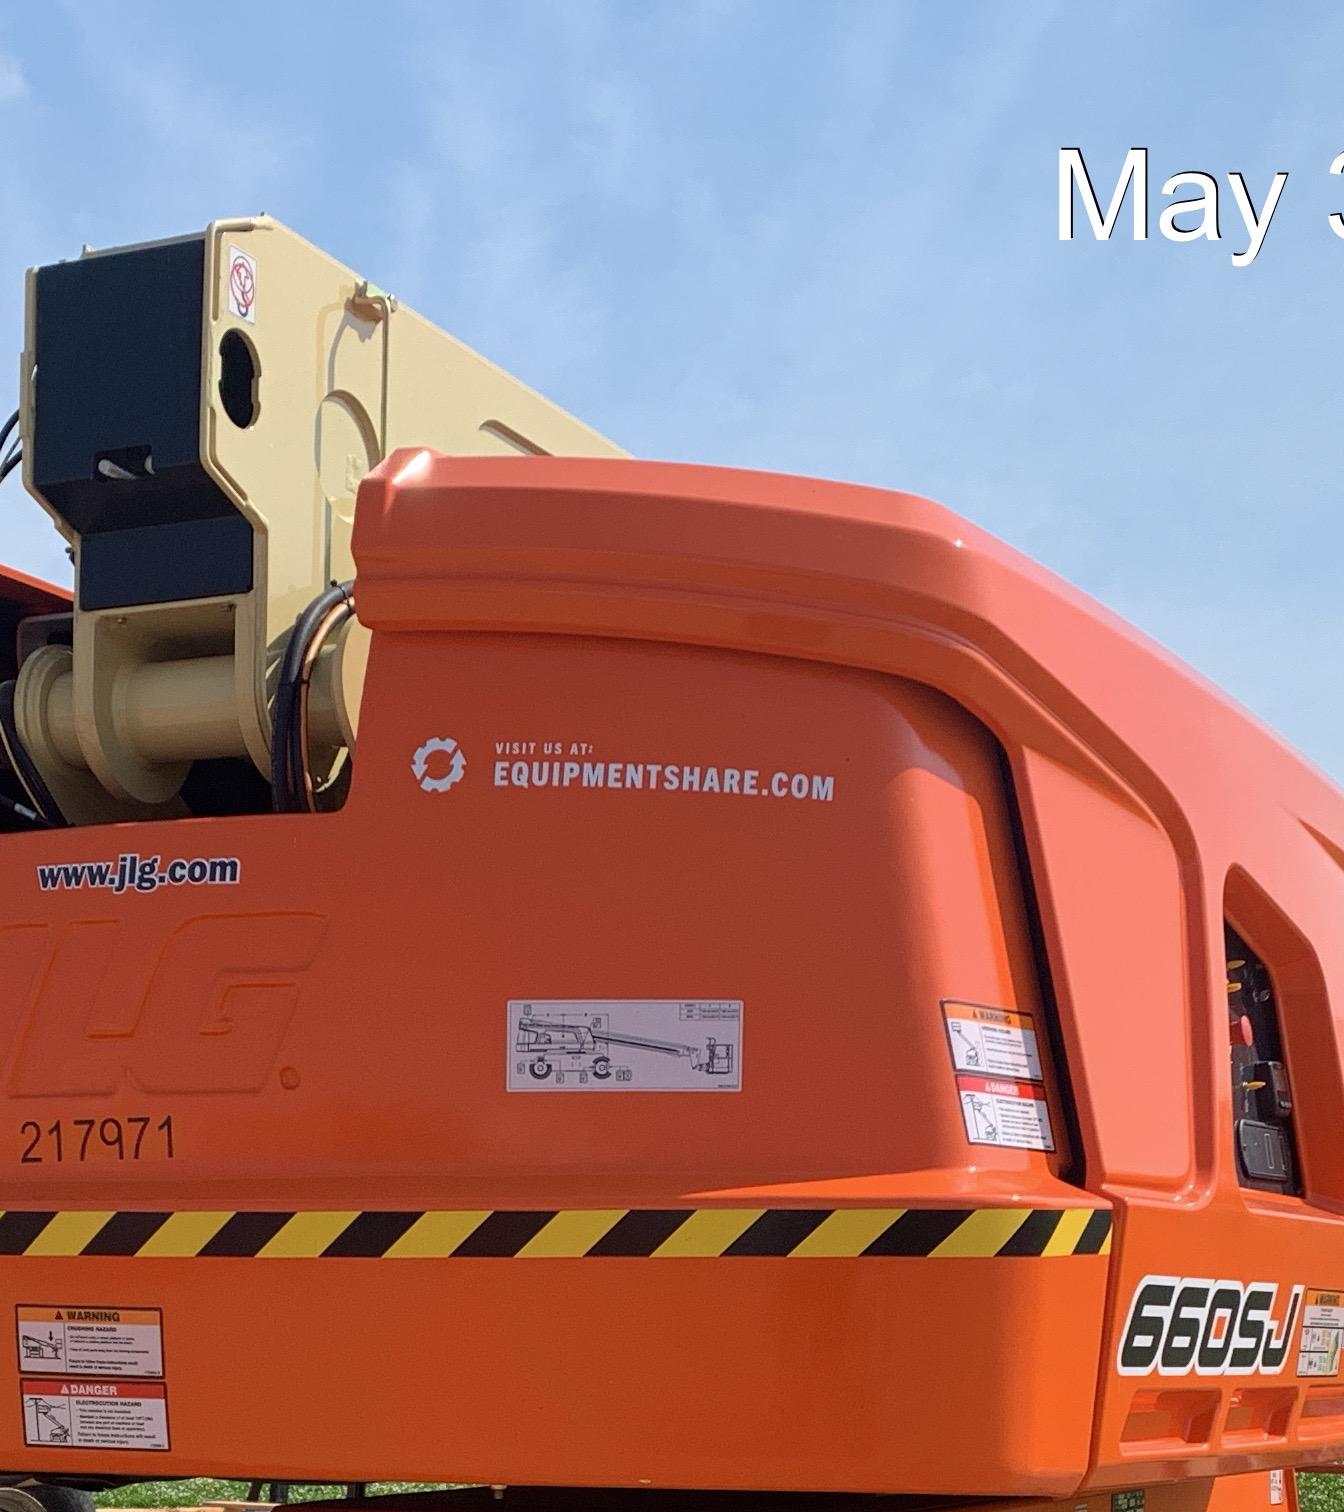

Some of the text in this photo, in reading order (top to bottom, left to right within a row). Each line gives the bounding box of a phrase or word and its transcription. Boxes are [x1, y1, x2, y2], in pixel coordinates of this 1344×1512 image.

[496, 742, 593, 756] VISIT US AT:
[493, 760, 835, 802] EQUIPMENTSHARE.COM
[38, 854, 240, 893] www.jlg.com
[20, 1115, 175, 1164] 217971
[66, 1310, 121, 1322] WARNING
[1119, 1280, 1303, 1372] 660SJ
[70, 1384, 118, 1396] DANGER
